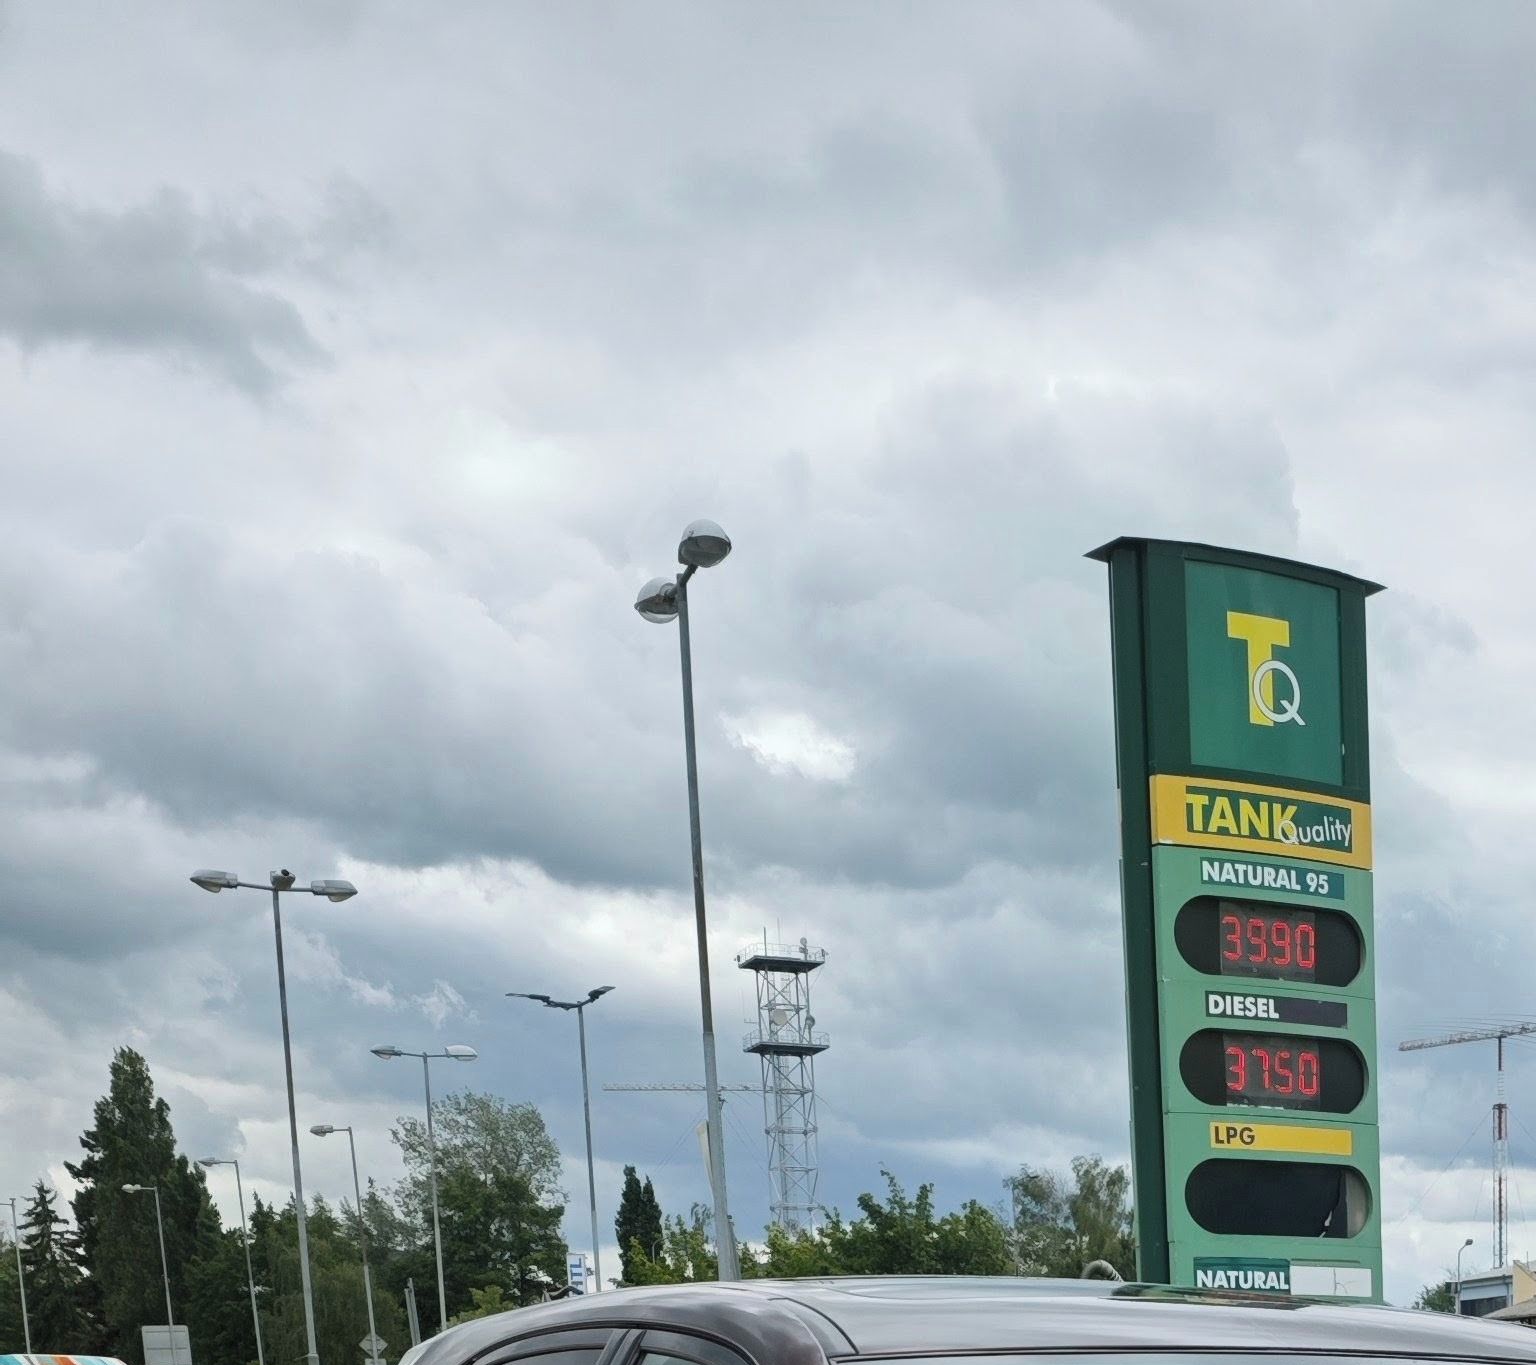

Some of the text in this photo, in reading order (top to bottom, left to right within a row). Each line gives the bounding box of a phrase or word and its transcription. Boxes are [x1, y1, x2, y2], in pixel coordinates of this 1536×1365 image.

[1185, 793, 1352, 847] TANK Quality
[1201, 860, 1330, 895] NATURAL 95
[1208, 994, 1280, 1020] DIESEL
[1214, 1126, 1256, 1147] LPG
[1196, 1269, 1290, 1291] NATURAL
